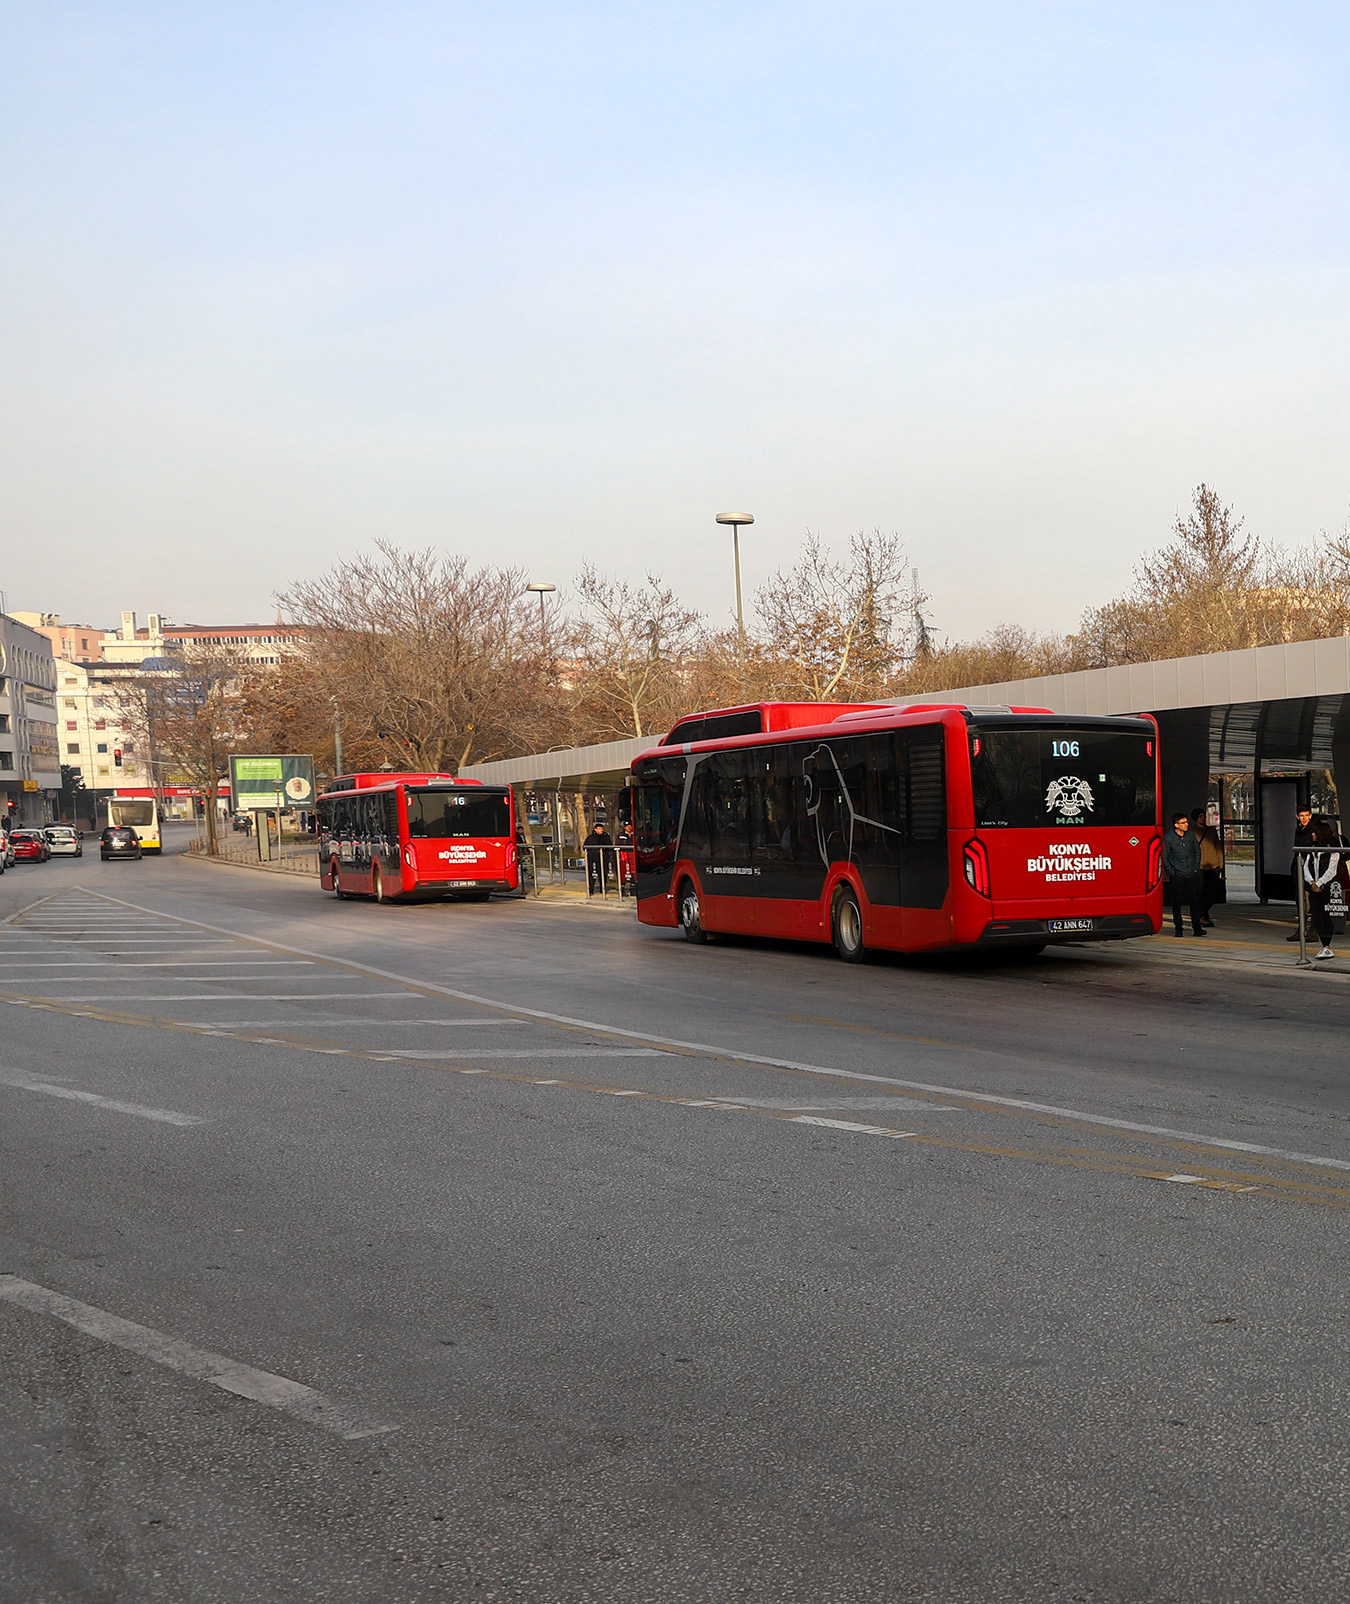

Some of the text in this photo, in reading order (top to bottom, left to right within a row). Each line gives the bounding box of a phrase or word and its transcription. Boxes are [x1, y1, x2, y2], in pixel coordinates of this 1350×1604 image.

[1052, 741, 1079, 756] 106
[453, 797, 465, 805] 16
[438, 850, 486, 859] BÜYÜKŞEHİR
[1049, 844, 1091, 855] KONYA
[1027, 855, 1111, 872] BÜYÜKŞEHİR
[1046, 871, 1095, 881] BELEDİYESİ
[1053, 921, 1062, 929] 42
[1078, 920, 1091, 928] 647
